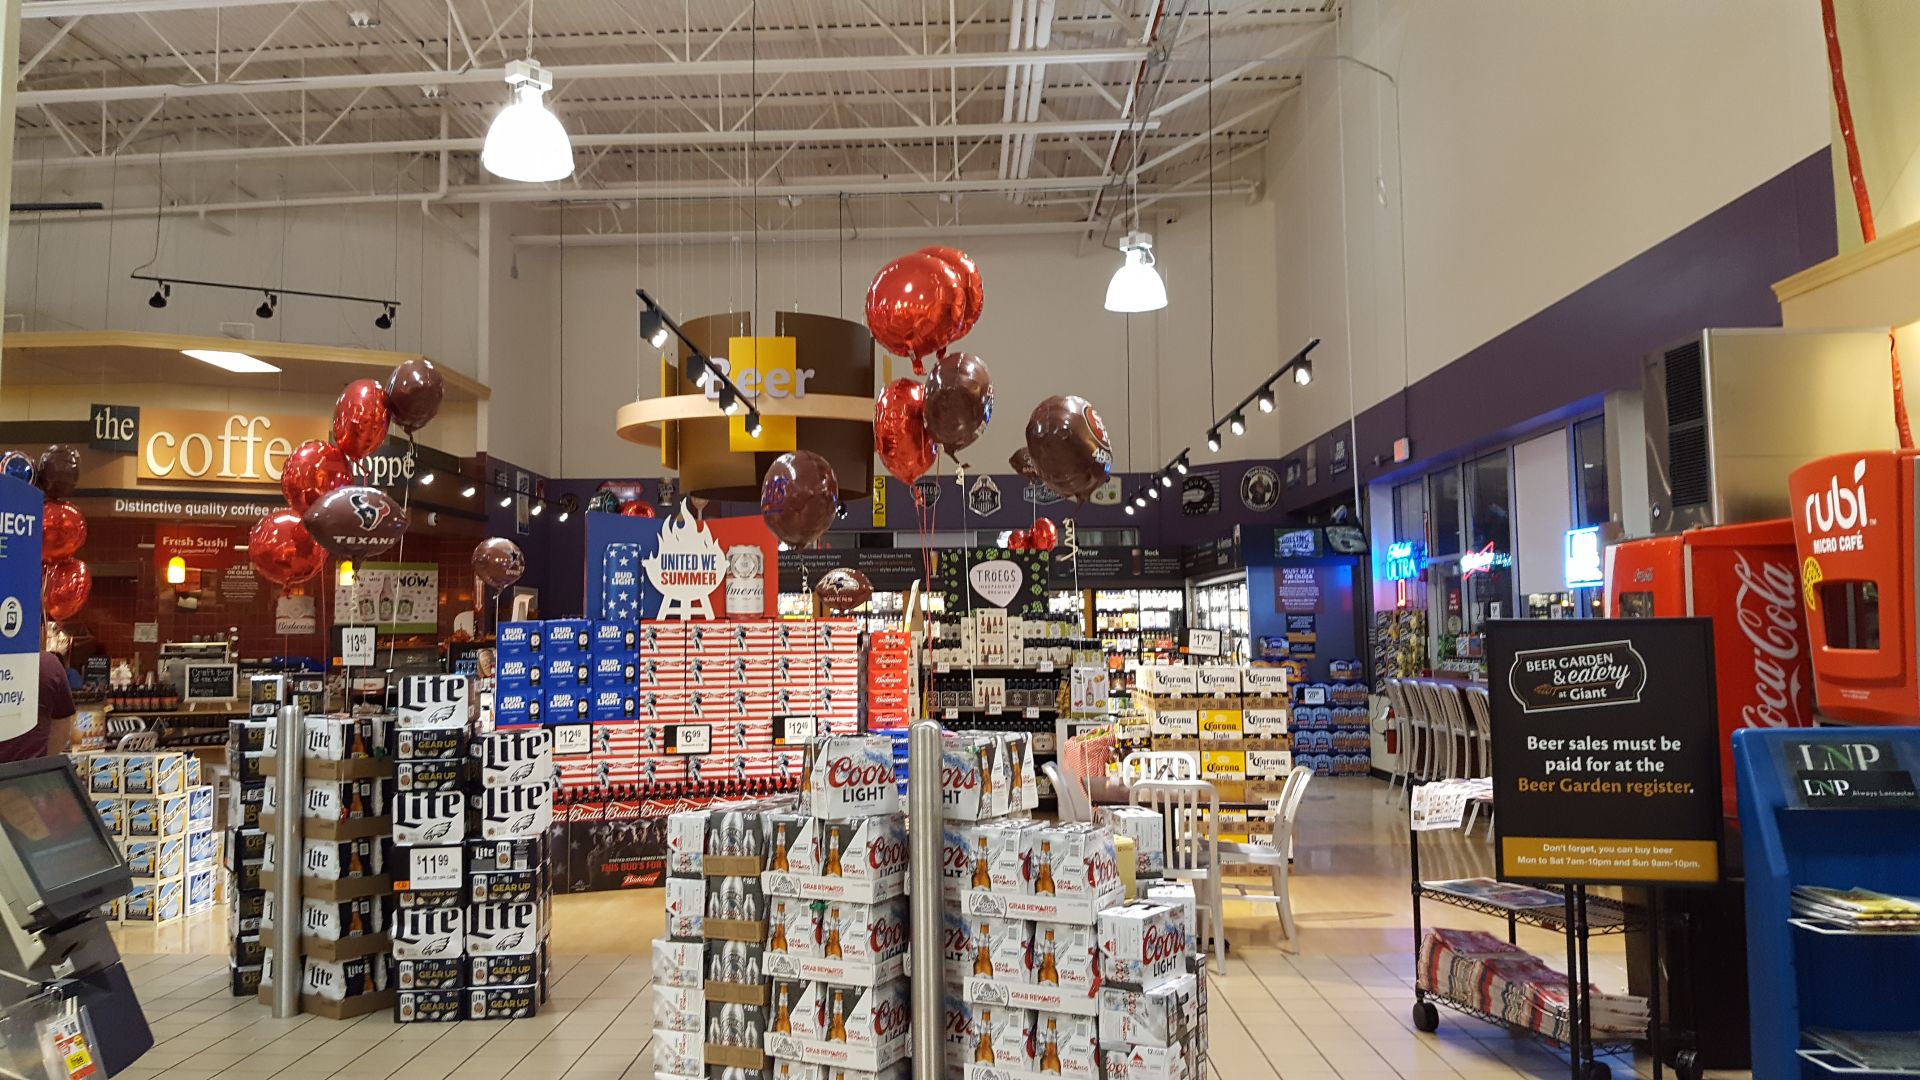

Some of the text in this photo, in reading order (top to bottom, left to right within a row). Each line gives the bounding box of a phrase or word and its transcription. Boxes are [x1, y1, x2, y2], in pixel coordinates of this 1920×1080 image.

[705, 357, 816, 401] Beer
[95, 407, 135, 441] the
[147, 415, 293, 480] coffe
[348, 452, 416, 486] oppe
[1805, 459, 1867, 533] rubi
[115, 499, 182, 514] Distinctive
[185, 502, 228, 522] quality
[231, 503, 270, 517] coffee
[162, 536, 228, 548] Fresh Sushi
[333, 535, 396, 545] TEXANS
[1813, 530, 1864, 554] MICRO CAFÉ
[660, 553, 717, 571] UNITED WE
[1386, 558, 1417, 580] ULTRA
[611, 577, 636, 585] LIGHT
[660, 571, 717, 585] SUMMER
[502, 633, 527, 641] LIGHT
[550, 632, 575, 640] LIGHT
[598, 631, 621, 639] LIGHT
[1526, 652, 1613, 672] BEER GARDEN
[1159, 674, 1191, 688] Corona
[1202, 674, 1235, 687] Corona
[1248, 673, 1281, 687] Corona
[1553, 662, 1630, 690] & eatery
[400, 676, 465, 712] Lite
[597, 698, 621, 706] LIGHT
[1570, 687, 1607, 700] Giant
[501, 702, 525, 710] LIGHT
[550, 700, 574, 708] LIGHT
[1159, 715, 1192, 729] Corona
[1204, 722, 1237, 731] Corona
[1248, 715, 1281, 729] Corona
[308, 730, 331, 751] Lite
[418, 740, 457, 749] GEAR UP
[681, 730, 701, 743] $699
[1527, 736, 1681, 751] Beer sales must be
[483, 733, 542, 771] Lite
[1799, 744, 1880, 771] LNP
[827, 756, 897, 788] Coors
[1207, 763, 1240, 772] Corona
[1253, 757, 1286, 770] Corona
[1545, 757, 1665, 775] paid for at the
[417, 772, 456, 781] GEAR UP
[943, 767, 977, 789] ors
[843, 786, 885, 803] LIGHT
[1518, 777, 1695, 797] Beer Garden register.
[1803, 779, 1850, 797] LNP
[308, 788, 329, 810] Lite
[483, 785, 543, 822] Lite
[394, 792, 461, 828] Lite
[475, 847, 494, 859] Lite
[1543, 843, 1673, 855] Don't forget, you can buy beer
[306, 849, 328, 871] Lite
[417, 854, 448, 874] $1199
[1517, 856, 1537, 864] Mon
[1549, 856, 1564, 865] Sat
[1566, 857, 1612, 867] 7am-10pm
[1632, 859, 1649, 867] Sun
[492, 883, 531, 892] GEAR UP
[1026, 905, 1057, 913] REWARDS
[307, 907, 329, 930] Lite
[393, 908, 459, 944] Lite
[467, 903, 533, 939] Lite
[1142, 925, 1185, 965] Coors
[348, 963, 364, 977] Lite
[1153, 955, 1177, 977] LIGHT
[309, 965, 332, 989] Lite
[1011, 992, 1061, 1003] GRAB REWARDS
